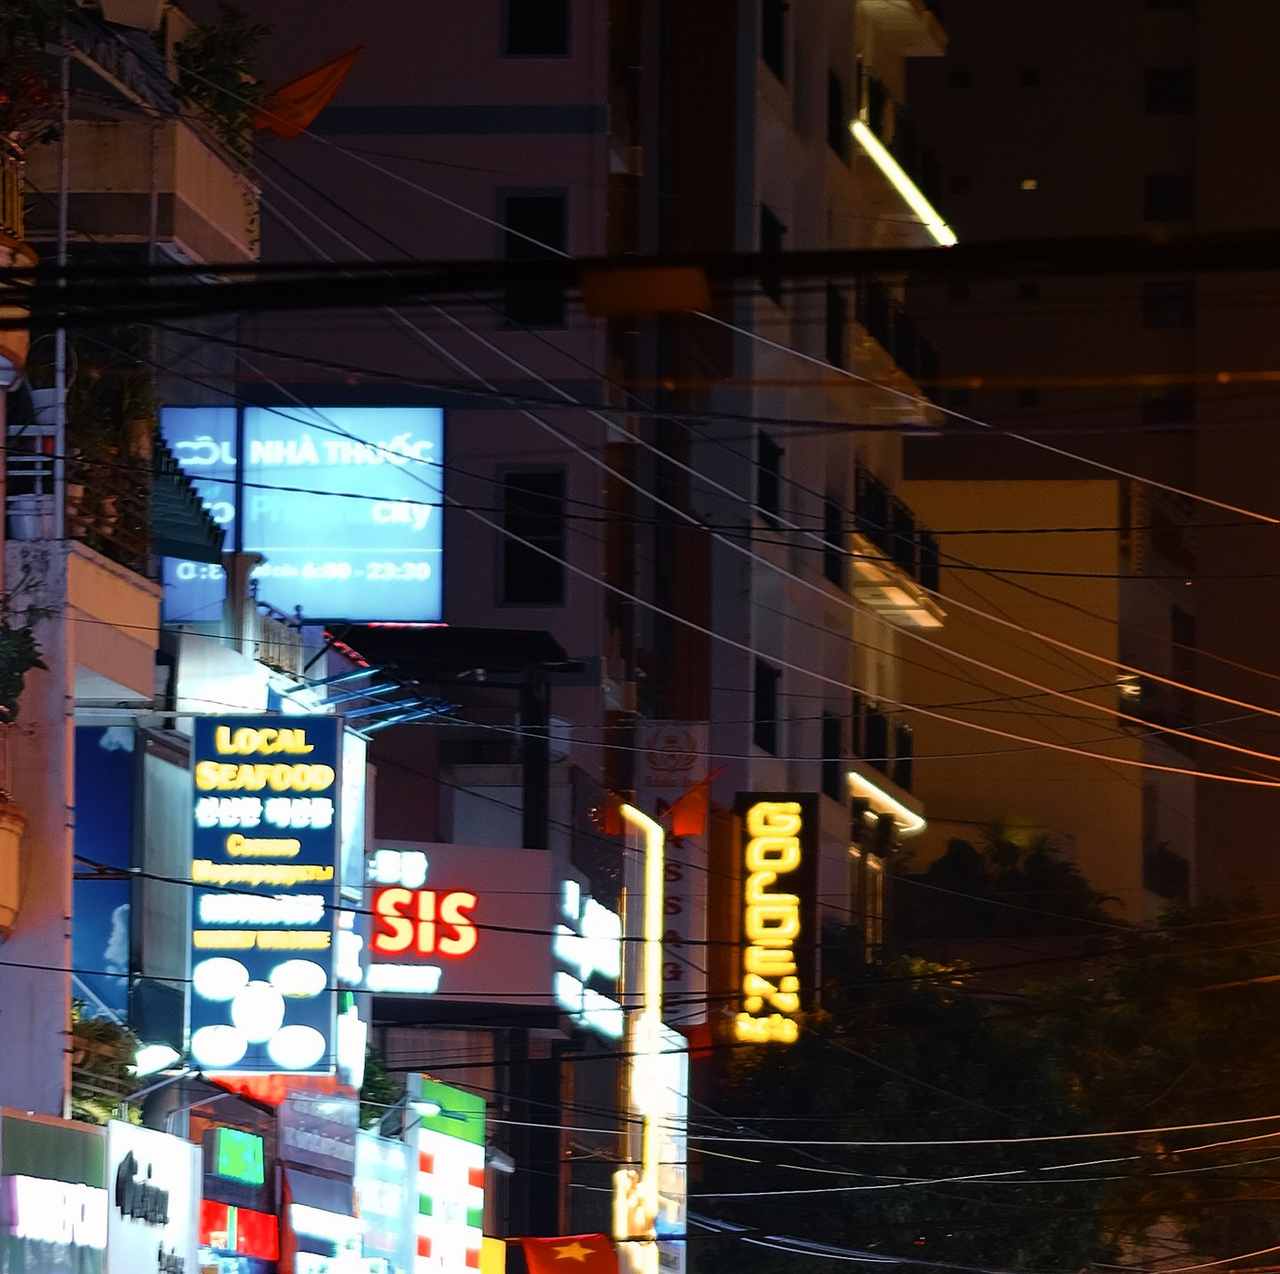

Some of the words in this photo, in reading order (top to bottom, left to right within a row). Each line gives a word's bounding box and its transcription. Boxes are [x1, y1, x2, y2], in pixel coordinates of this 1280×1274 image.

[251, 434, 319, 465] NHÀ
[216, 726, 314, 754] LOCAL
[195, 761, 335, 791] SEAFOOD
